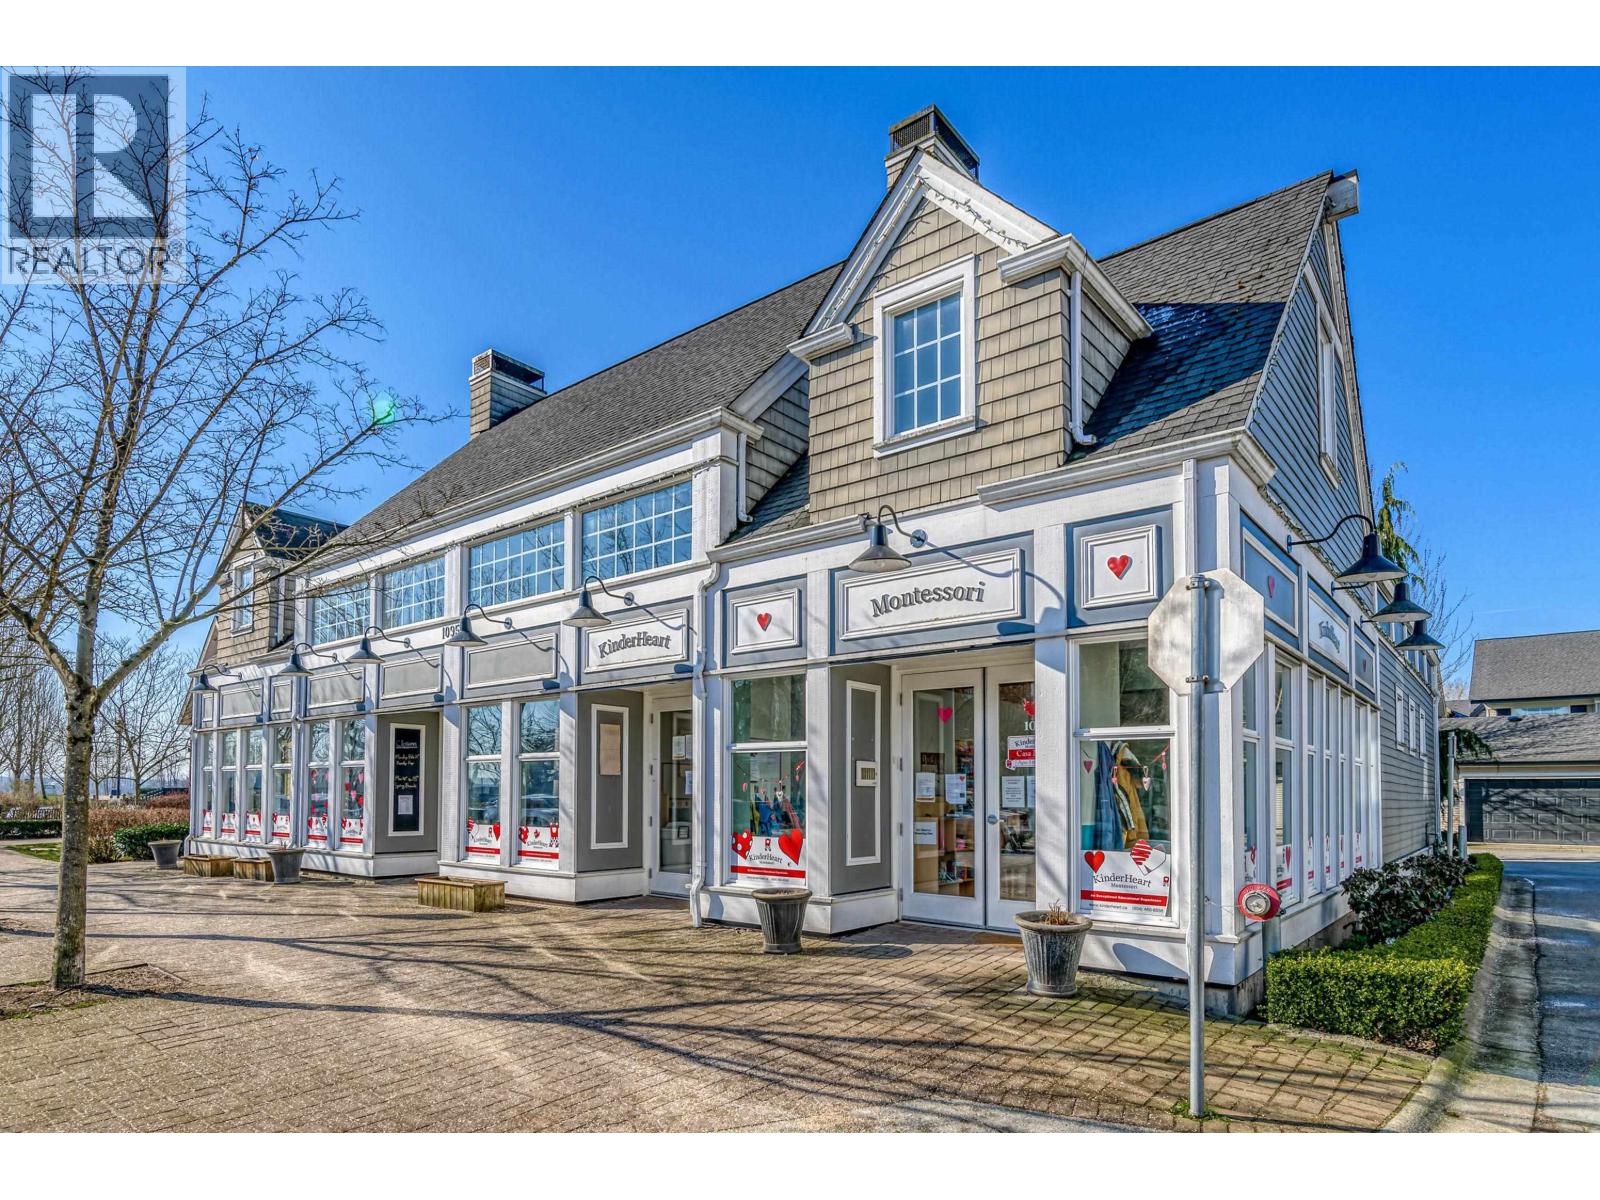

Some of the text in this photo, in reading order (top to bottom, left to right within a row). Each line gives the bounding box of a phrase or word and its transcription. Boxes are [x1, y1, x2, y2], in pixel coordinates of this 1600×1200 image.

[870, 581, 986, 617] Montessori
[598, 631, 672, 659] KinderHeart
[749, 853, 783, 863] KinderHeart
[1093, 873, 1152, 887] KinderHeart
